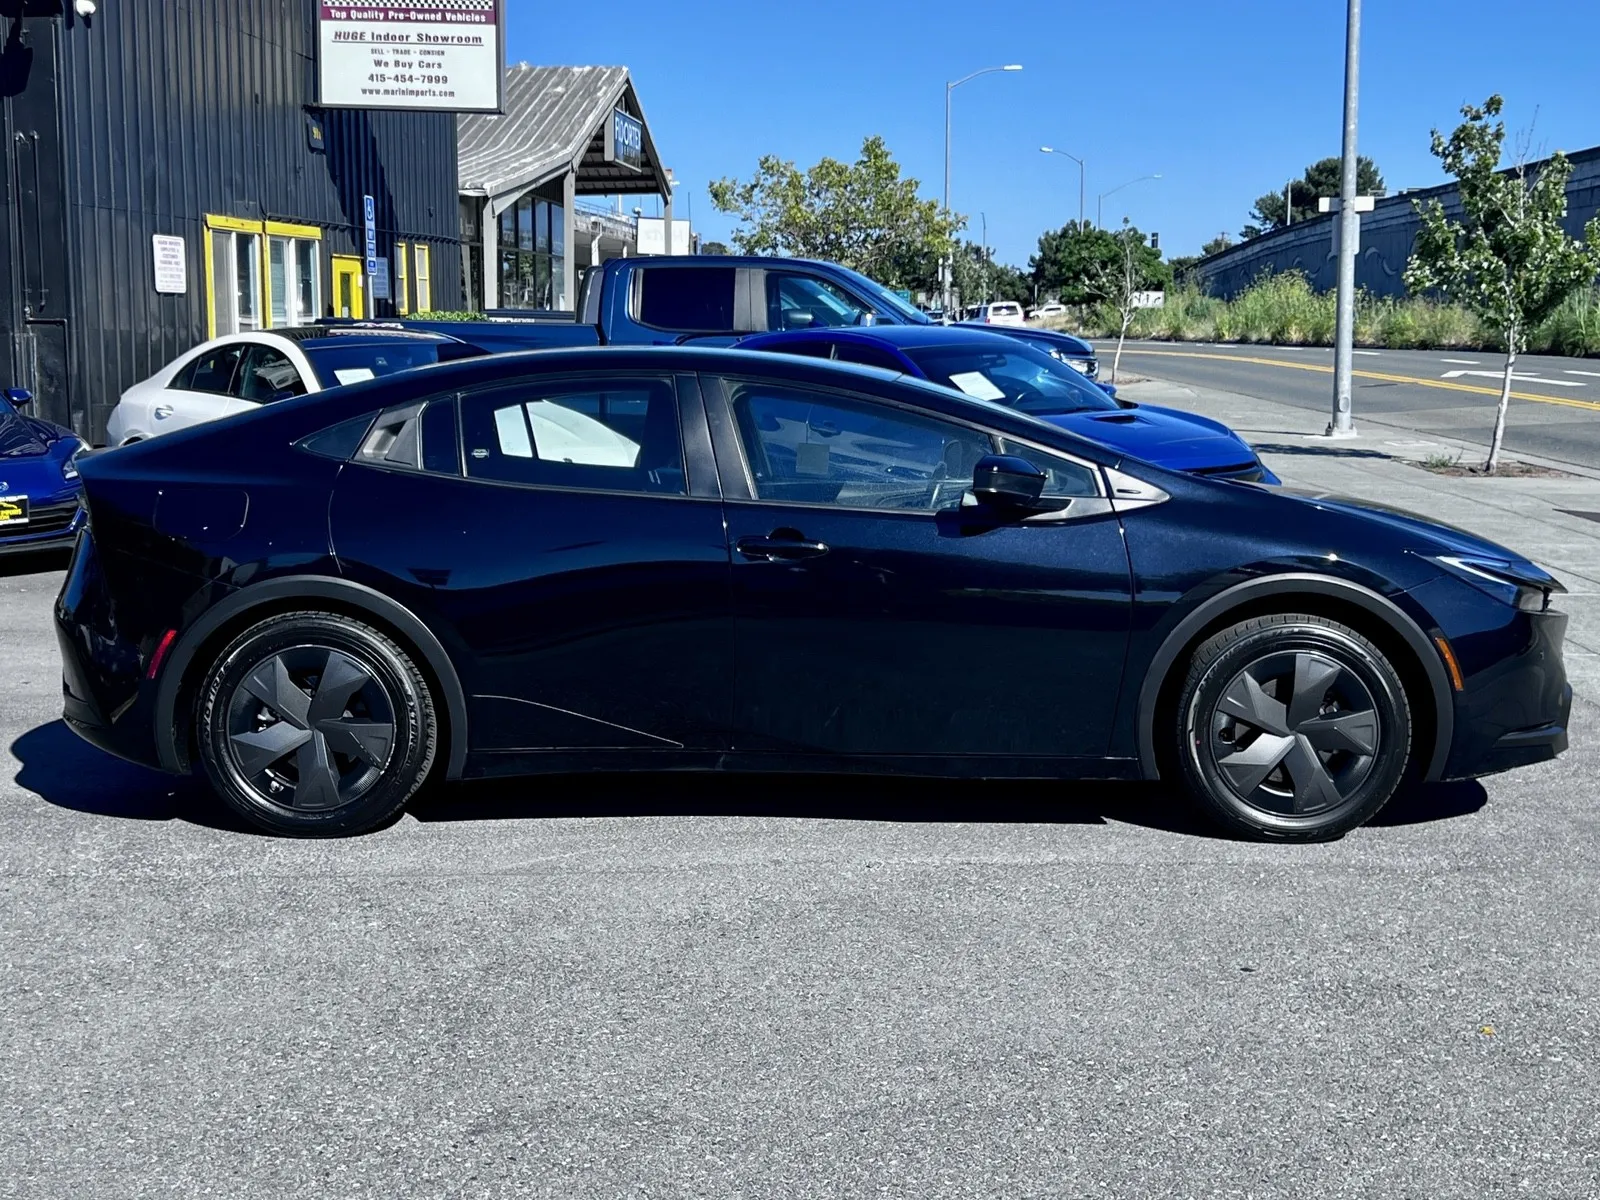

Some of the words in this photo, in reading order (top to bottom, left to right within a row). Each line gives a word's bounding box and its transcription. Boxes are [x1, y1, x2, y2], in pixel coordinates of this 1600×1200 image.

[330, 9, 346, 19] Top
[350, 9, 384, 20] Quality
[388, 10, 442, 20] Pre-Owned
[445, 12, 486, 22] Vehicles
[334, 31, 366, 40] HUGE
[371, 32, 411, 42] Indoor
[416, 33, 482, 44] Showroom
[374, 59, 389, 68] We
[394, 60, 413, 69] Buy
[418, 60, 442, 69] Cars
[368, 74, 448, 84] 415-454-7999
[361, 88, 455, 97] www.marinimports.com
